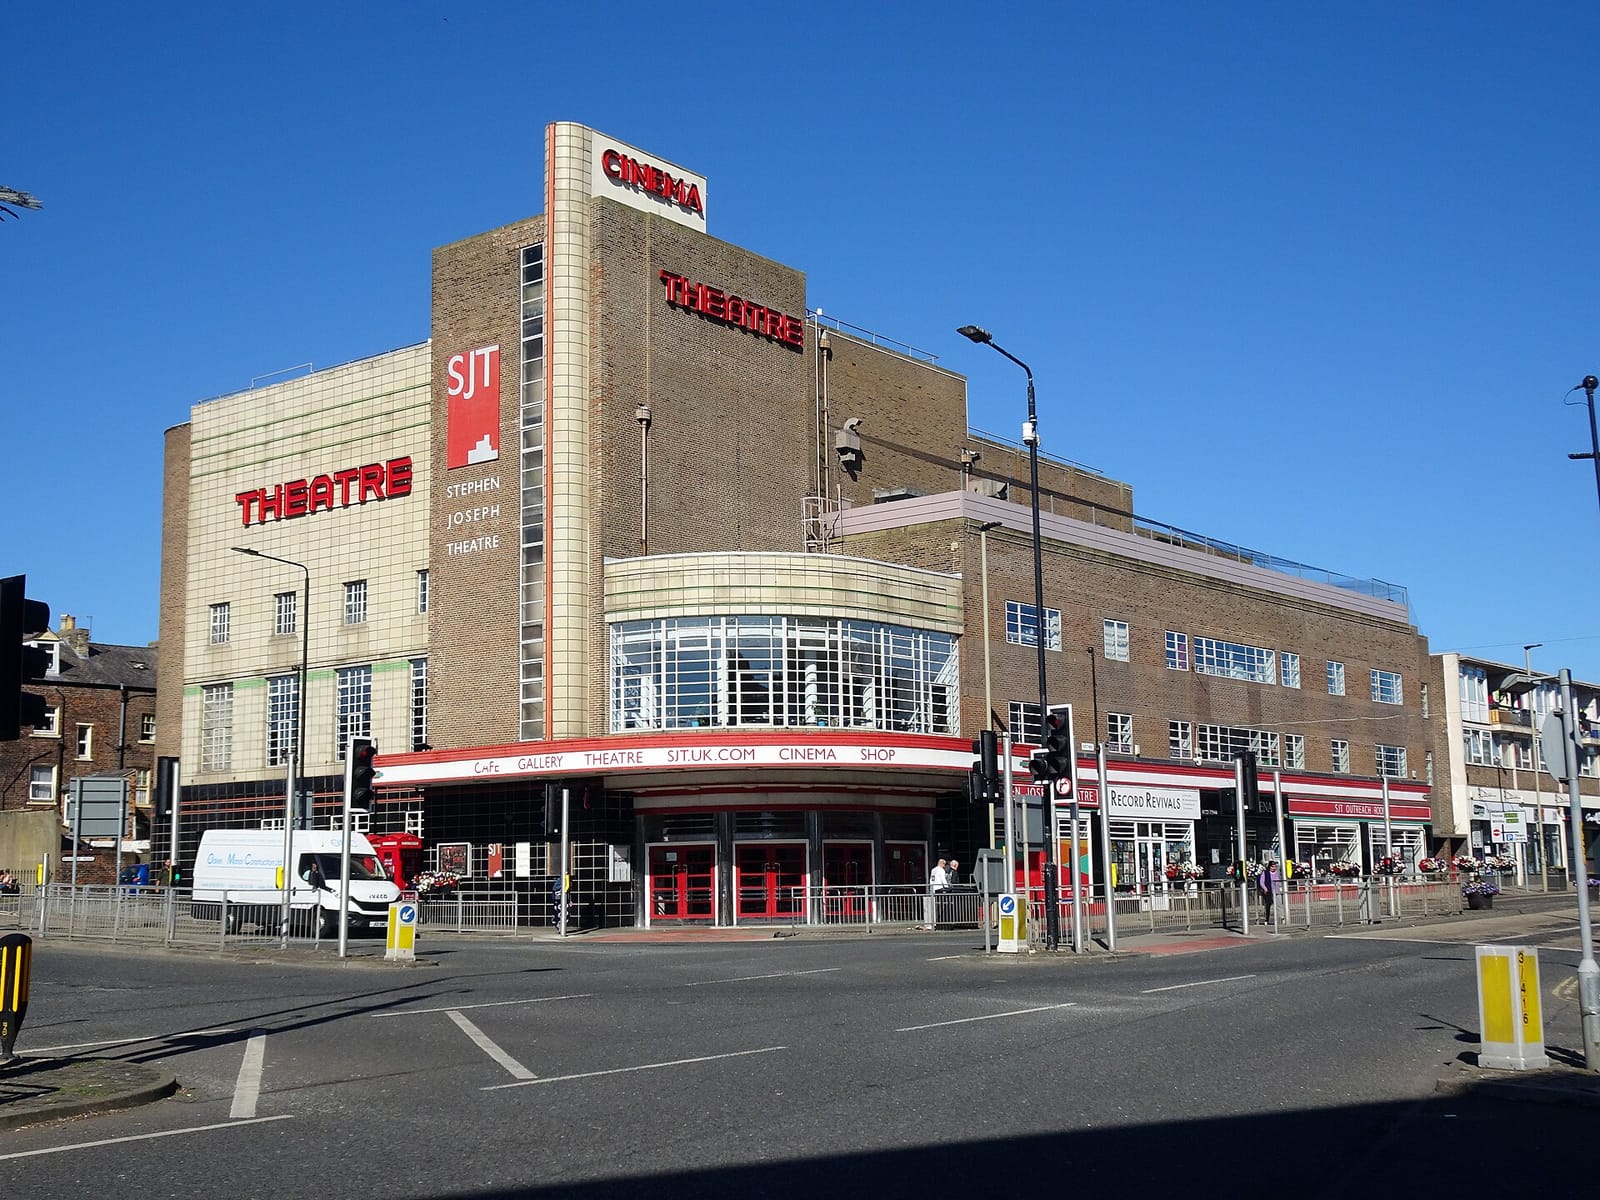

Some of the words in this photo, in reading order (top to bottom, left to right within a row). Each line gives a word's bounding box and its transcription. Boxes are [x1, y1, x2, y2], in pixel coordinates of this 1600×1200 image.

[601, 149, 703, 213] CINEMA
[660, 268, 804, 347] THEATRE
[448, 345, 500, 400] SJT
[236, 456, 413, 527] THEATRE
[447, 476, 500, 498] STEPHEN
[447, 505, 500, 529] JOSEPH
[447, 535, 500, 556] THEATRE
[518, 756, 563, 770] GALLERY
[584, 751, 643, 765] THEATRE
[779, 747, 837, 761] CINEMA
[860, 748, 896, 761] SHOP
[1110, 790, 1144, 807] RECORD
[1146, 792, 1181, 810] REVIVALS
[488, 843, 502, 857] SJT
